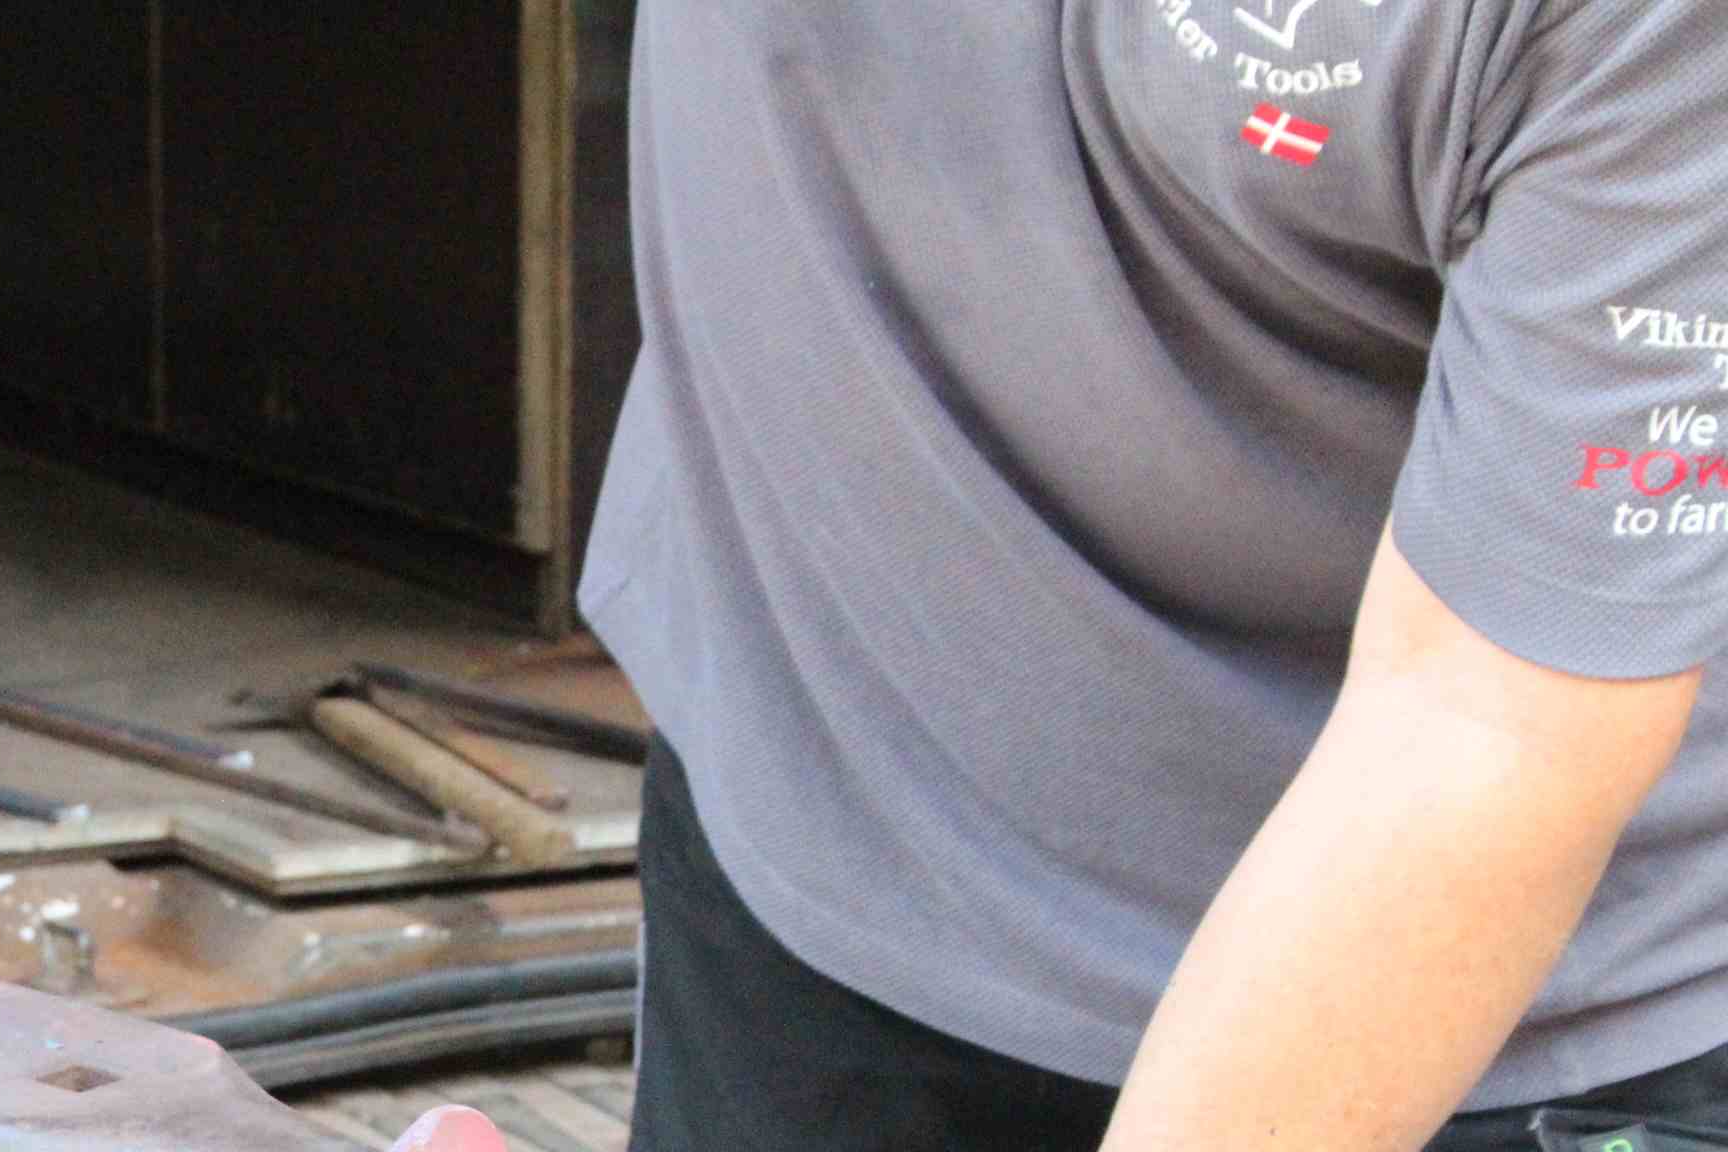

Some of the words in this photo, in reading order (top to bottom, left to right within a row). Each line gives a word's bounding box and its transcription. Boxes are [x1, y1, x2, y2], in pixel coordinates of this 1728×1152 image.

[1234, 52, 1363, 94] Tools
[1648, 405, 1719, 446] We
[1613, 500, 1659, 536] to
